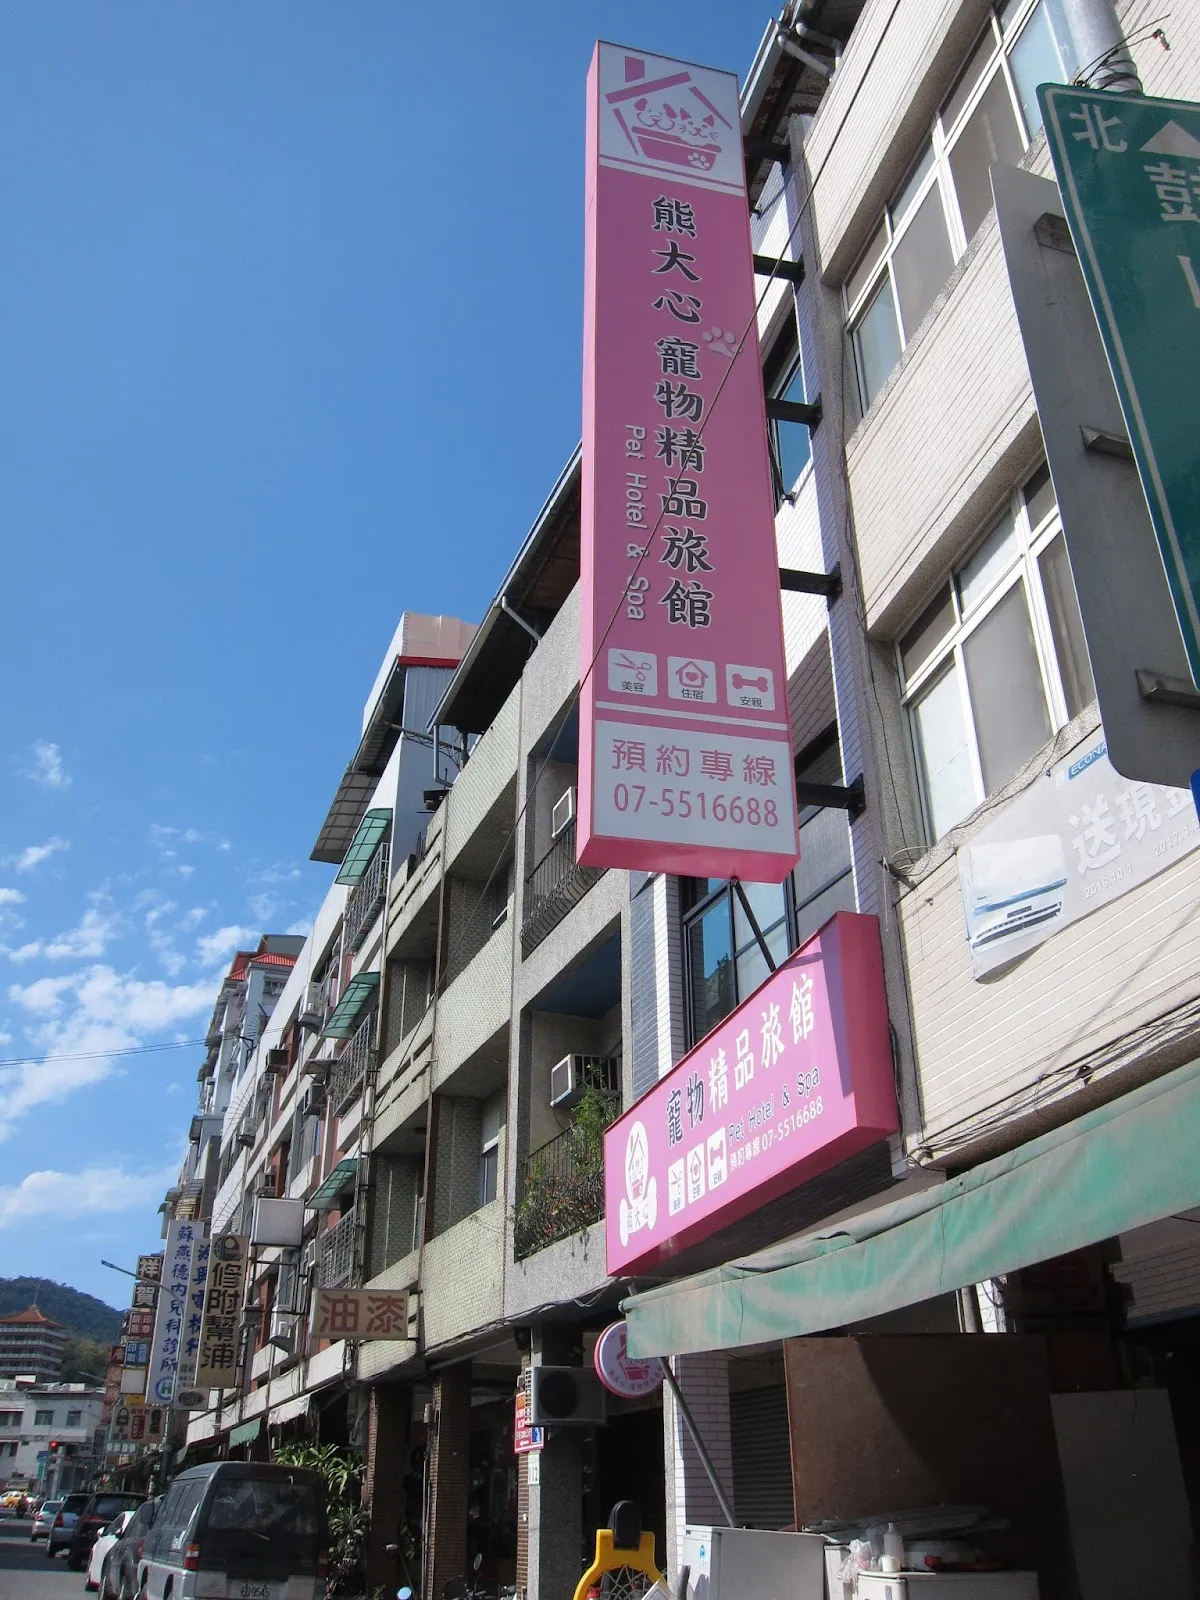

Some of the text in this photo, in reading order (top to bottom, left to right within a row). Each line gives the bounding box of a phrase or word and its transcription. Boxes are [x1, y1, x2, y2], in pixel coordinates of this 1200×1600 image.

[1069, 103, 1128, 153] 北
[624, 424, 651, 622] Pet Hotel & Spa
[621, 680, 646, 693] 美容
[681, 688, 705, 701] 住宿
[740, 696, 763, 708] 安親
[612, 738, 778, 788] 預約專線
[613, 782, 780, 828] 07-5516688
[665, 972, 816, 1149] 寵物精品旅館
[728, 1066, 819, 1147] Pet Hotel & Spa
[761, 1096, 824, 1151] 07-5516688
[318, 1293, 405, 1333] 油漆
